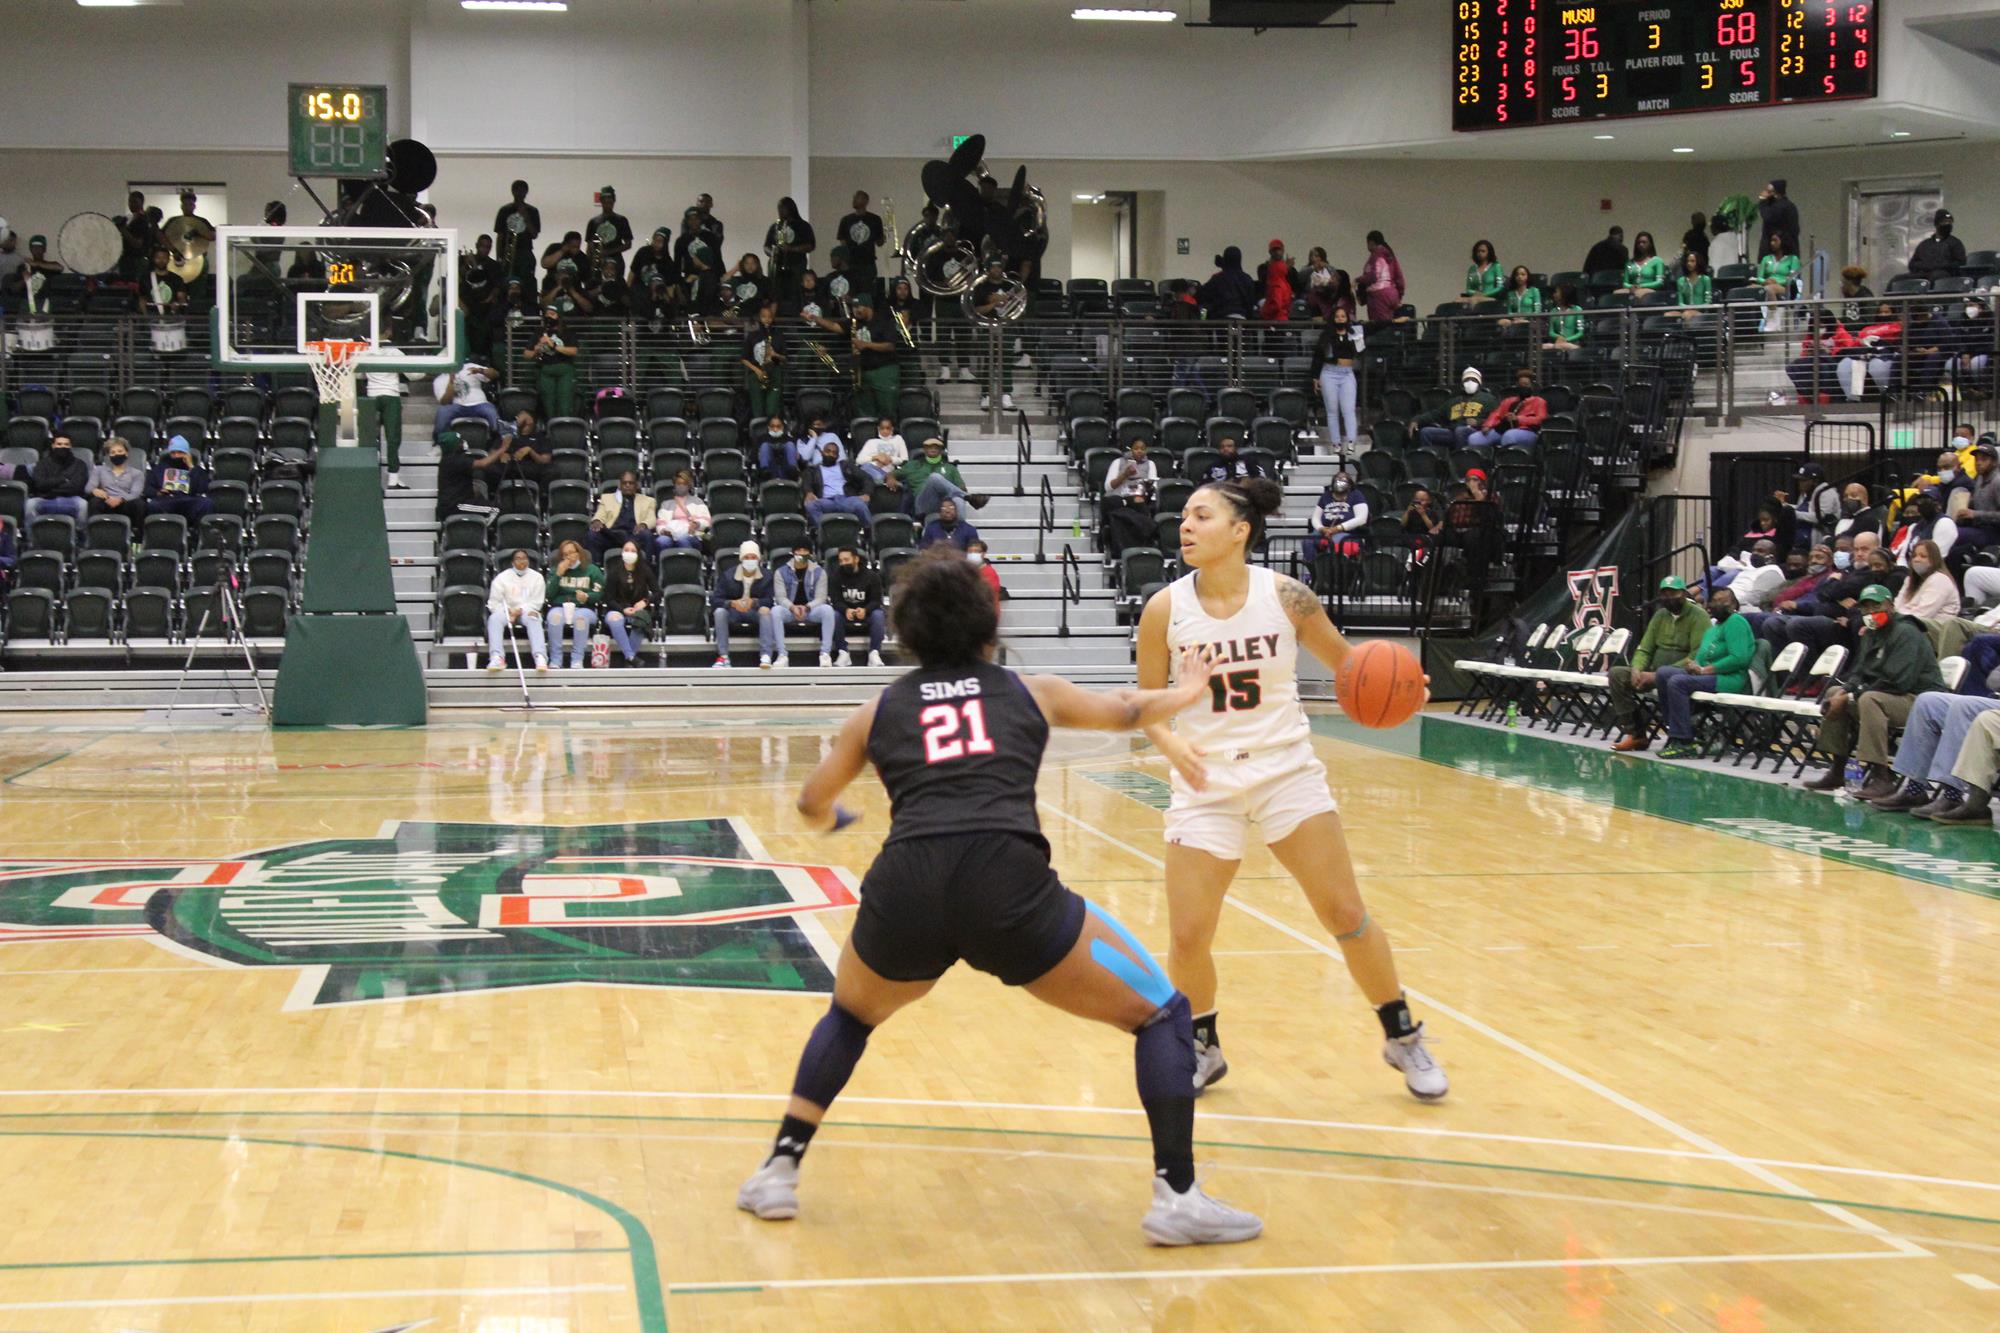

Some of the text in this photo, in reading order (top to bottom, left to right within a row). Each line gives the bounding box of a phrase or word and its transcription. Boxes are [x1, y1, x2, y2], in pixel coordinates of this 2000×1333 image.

[1459, 1, 1480, 19] 03
[1638, 8, 1671, 22] PERIOD
[1787, 4, 1868, 29] 12 3 12
[1465, 16, 1536, 40] 15 1 0
[1648, 24, 1661, 49] 3
[1717, 11, 1757, 46] 68
[1780, 28, 1868, 52] 21 1 4
[1459, 38, 1536, 61] 20 2 2
[1564, 27, 1599, 60] 36
[1729, 47, 1760, 60] FOULS
[1590, 61, 1614, 73] T.O.L.
[1625, 54, 1685, 70] PLAYER FOUL
[1694, 52, 1720, 63] T.O.L.
[1780, 49, 1868, 75] 23 1 0
[1459, 59, 1536, 82] 23 1 8
[1552, 64, 1581, 76] FOULS
[1701, 64, 1713, 89] 3
[1739, 60, 1756, 86] 5
[1459, 80, 1536, 104] 25 3 5
[1562, 76, 1577, 101] 5
[1596, 73, 1609, 98] 3
[1823, 75, 1836, 94] 5
[307, 93, 361, 121] 15.0
[1637, 98, 1670, 111] MATCH
[1729, 91, 1760, 104] SCORE
[1496, 103, 1508, 122] 5
[1551, 106, 1581, 118] SCORE
[1178, 633, 1279, 665] LLEY
[920, 677, 982, 701] SIMS
[1208, 668, 1262, 714] 15
[919, 698, 997, 766] 21
